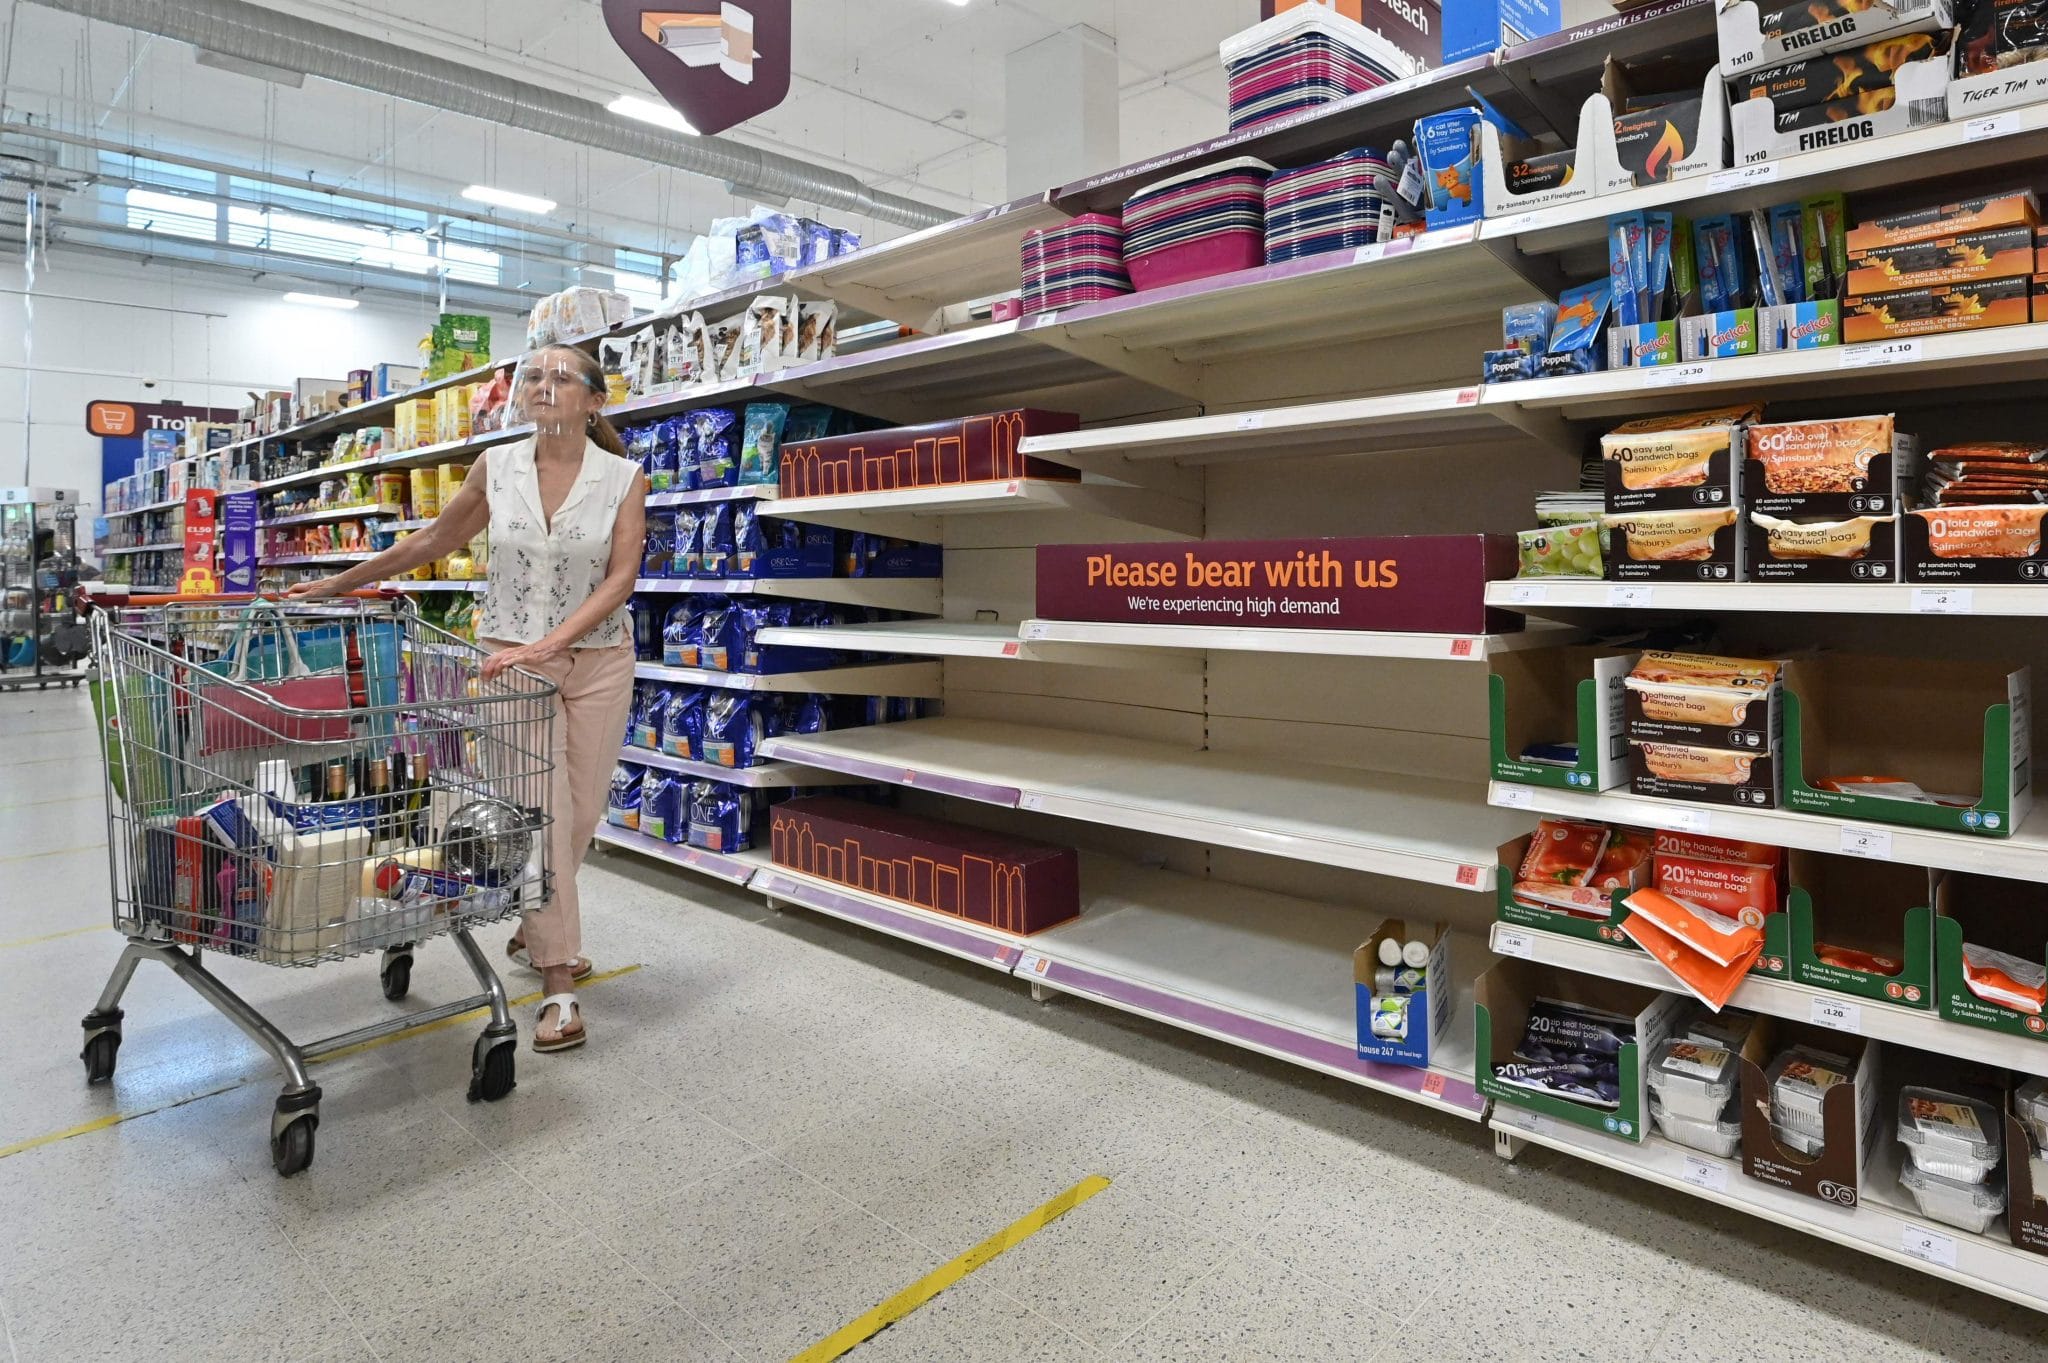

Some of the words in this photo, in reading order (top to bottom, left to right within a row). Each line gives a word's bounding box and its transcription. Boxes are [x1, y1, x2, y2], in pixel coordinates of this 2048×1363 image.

[1382, 0, 1429, 35] leach
[1569, 28, 1594, 41] This
[1596, 17, 1628, 34] shelf
[1630, 12, 1641, 23] is
[1644, 7, 1664, 20] for
[1781, 17, 1857, 52] FIRELOG
[1730, 51, 1754, 67] 1x10
[1750, 69, 1782, 85] TIGER
[1785, 61, 1807, 76] TIM
[1771, 77, 1806, 92] firelog
[1963, 86, 2000, 105] TIGER
[2004, 79, 2029, 95] TIM
[1436, 122, 1446, 130] cat
[1778, 111, 1800, 127] TIM
[1210, 137, 1236, 151] Please
[1236, 131, 1251, 142] ask
[1253, 128, 1263, 137] us
[1264, 124, 1273, 134] to
[1274, 118, 1294, 132] help
[1295, 112, 1316, 125] with
[1317, 104, 1341, 118] these
[1427, 126, 1436, 139] 6
[1449, 126, 1465, 135] liners
[1799, 120, 1874, 152] FIRELOG
[1744, 150, 1767, 164] 1x10
[1100, 174, 1118, 185] shelf
[1125, 168, 1136, 177] for
[1136, 157, 1171, 173] colleague
[1171, 153, 1185, 162] use
[1744, 166, 1770, 178] £2.20
[1496, 204, 1505, 212] By
[1506, 196, 1541, 209] Sainsbury's
[1542, 195, 1550, 203] 32
[1550, 188, 1587, 201] Firelighters
[1956, 236, 1978, 244] EXTRA
[1978, 233, 1997, 241] LONG
[1998, 229, 2029, 238] MATCHES
[1973, 282, 1992, 290] LONG
[1992, 278, 2023, 287] MATCHES
[1789, 312, 1833, 340] Cricket
[1710, 320, 1751, 348] Cricket
[1809, 333, 1830, 344] x18
[1633, 332, 1671, 358] Cricket
[1729, 340, 1748, 351] x18
[1882, 343, 1912, 354] £1.10
[1541, 353, 1571, 367] Poppell
[1650, 351, 1668, 361] x18
[1492, 360, 1520, 374] Poppell
[1679, 367, 1704, 377] £3.30
[1633, 445, 1653, 454] easy
[1655, 444, 1674, 452] seal
[1758, 433, 1785, 451] 60
[1785, 440, 1832, 451] sandwich
[1835, 438, 1863, 449] bags
[1611, 447, 1633, 462] 60
[1634, 450, 1675, 461] sandwich
[1676, 450, 1699, 460] bags
[1948, 519, 1970, 529] fold
[1972, 520, 1999, 528] over
[1781, 529, 1803, 538] easy
[1806, 528, 1828, 537] seal
[1948, 528, 2002, 538] sandwich
[2006, 527, 2037, 537] bags
[648, 536, 673, 553] ONE
[1086, 554, 1177, 588] Please
[1185, 552, 1256, 588] bear
[1264, 550, 1343, 589] with
[1354, 558, 1399, 589] us
[1959, 561, 1977, 570] bags
[1918, 569, 1927, 578] by
[1926, 569, 1961, 577] Sainsbury's
[1128, 595, 1160, 612] We're
[1163, 597, 1244, 617] experiencing
[1246, 596, 1277, 616] high
[1280, 598, 1340, 615] demand
[1937, 596, 1947, 604] £2
[1648, 690, 1687, 701] patterned
[1649, 698, 1685, 709] sandwich
[1686, 702, 1707, 712] bags
[1652, 743, 1689, 754] patterned
[1654, 751, 1689, 761] sandwich
[1689, 753, 1709, 763] bags
[690, 802, 716, 823] ONE
[1658, 835, 1680, 853] 20
[1858, 837, 1868, 846] £2
[1680, 839, 1691, 848] tie
[1693, 841, 1724, 854] handle
[1726, 847, 1748, 859] food
[1662, 864, 1685, 883] 20
[1685, 867, 1696, 876] tie
[1697, 869, 1728, 881] handle
[1730, 872, 1753, 884] food
[1684, 876, 1691, 884] &
[1692, 877, 1722, 889] freezer
[1724, 881, 1748, 894] bags
[1663, 884, 1674, 896] by
[1673, 885, 1719, 901] Sainsbury's
[1802, 963, 1810, 971] 20
[1810, 965, 1825, 974] food
[1825, 968, 1831, 976] &
[1830, 969, 1851, 980] freezer
[1851, 973, 1868, 985] bags
[1802, 970, 1810, 980] by
[1810, 972, 1840, 985] Sainsbury's
[1951, 994, 1961, 1002] 40
[1823, 1007, 1844, 1019] £1.20
[1951, 999, 1968, 1010] food
[1968, 1003, 1975, 1011] &
[1975, 1004, 1999, 1014] freezer
[1999, 1008, 2019, 1021] bags
[1952, 1008, 1961, 1017] by
[1960, 1009, 1997, 1023] Sainsbury's
[1530, 1015, 1550, 1032] 20
[1562, 1020, 1578, 1029] seal
[1579, 1022, 1597, 1031] food
[1549, 1026, 1556, 1034] &
[1557, 1027, 1582, 1037] freezer
[1583, 1031, 1602, 1042] bags
[1360, 1043, 1380, 1055] house
[1381, 1046, 1394, 1057] 247
[1699, 1167, 1708, 1176] £2
[2022, 1220, 2031, 1228] 10
[2031, 1223, 2043, 1231] foil
[1921, 1239, 1932, 1249] £2
